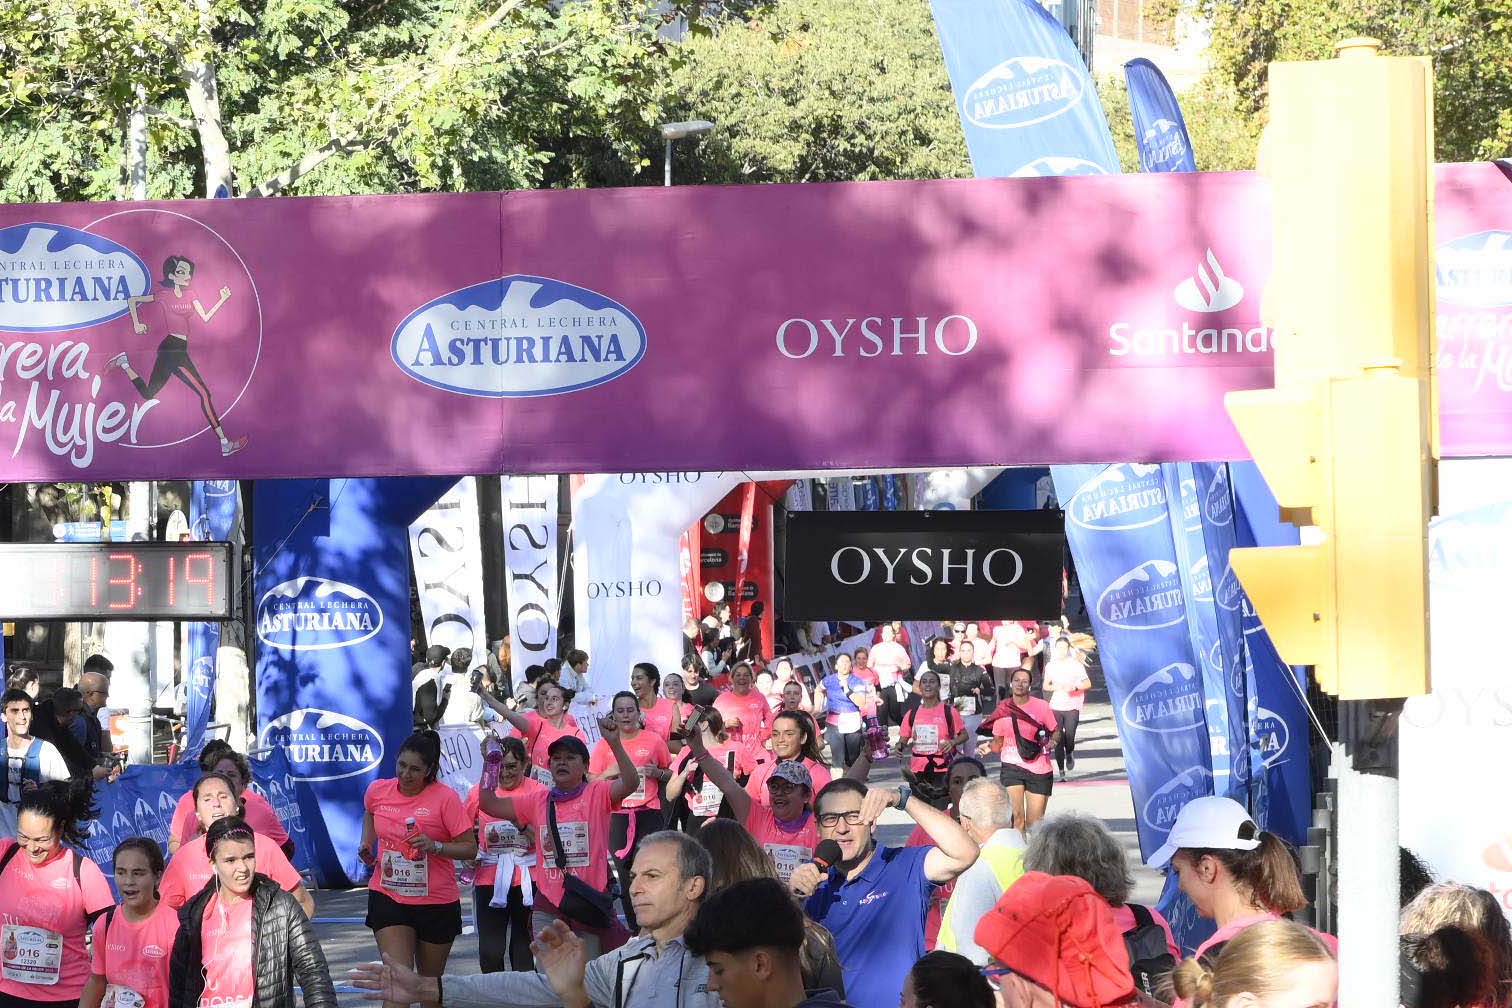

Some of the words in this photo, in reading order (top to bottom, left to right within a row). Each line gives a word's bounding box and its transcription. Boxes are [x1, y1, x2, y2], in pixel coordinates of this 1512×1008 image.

[54, 258, 126, 271] LECHERA
[451, 318, 529, 331] CENTRAL
[537, 316, 618, 328] LECHERA
[411, 322, 627, 367] ASTURIANA
[775, 314, 978, 359] OYSHO
[11, 374, 161, 468] Mujer
[830, 545, 1023, 586] OYSHO
[587, 579, 663, 601] OYSHO
[261, 606, 374, 634] ASTURIANA
[394, 869, 411, 877] 016
[776, 862, 794, 871] 016
[19, 949, 40, 958] 016
